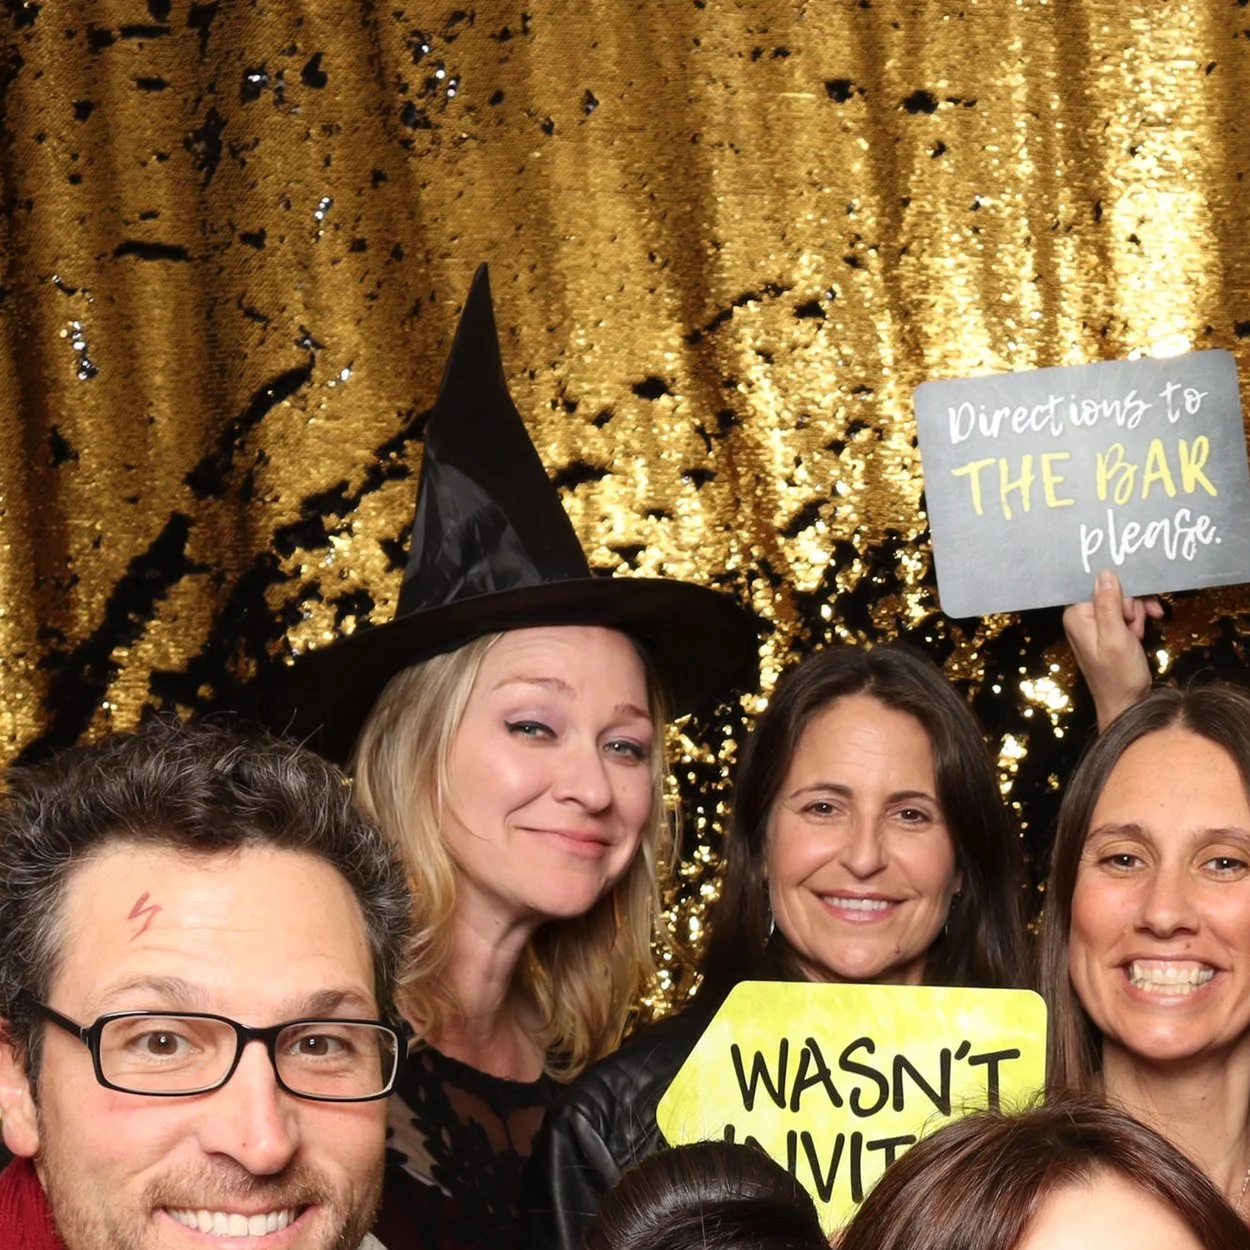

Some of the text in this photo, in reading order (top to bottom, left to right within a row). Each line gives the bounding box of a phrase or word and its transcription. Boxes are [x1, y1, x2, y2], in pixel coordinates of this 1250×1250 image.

[948, 381, 1209, 444] Directions to
[951, 435, 1218, 520] THE BAR
[1079, 508, 1222, 573] please.
[730, 1037, 1021, 1118] WASN'T
